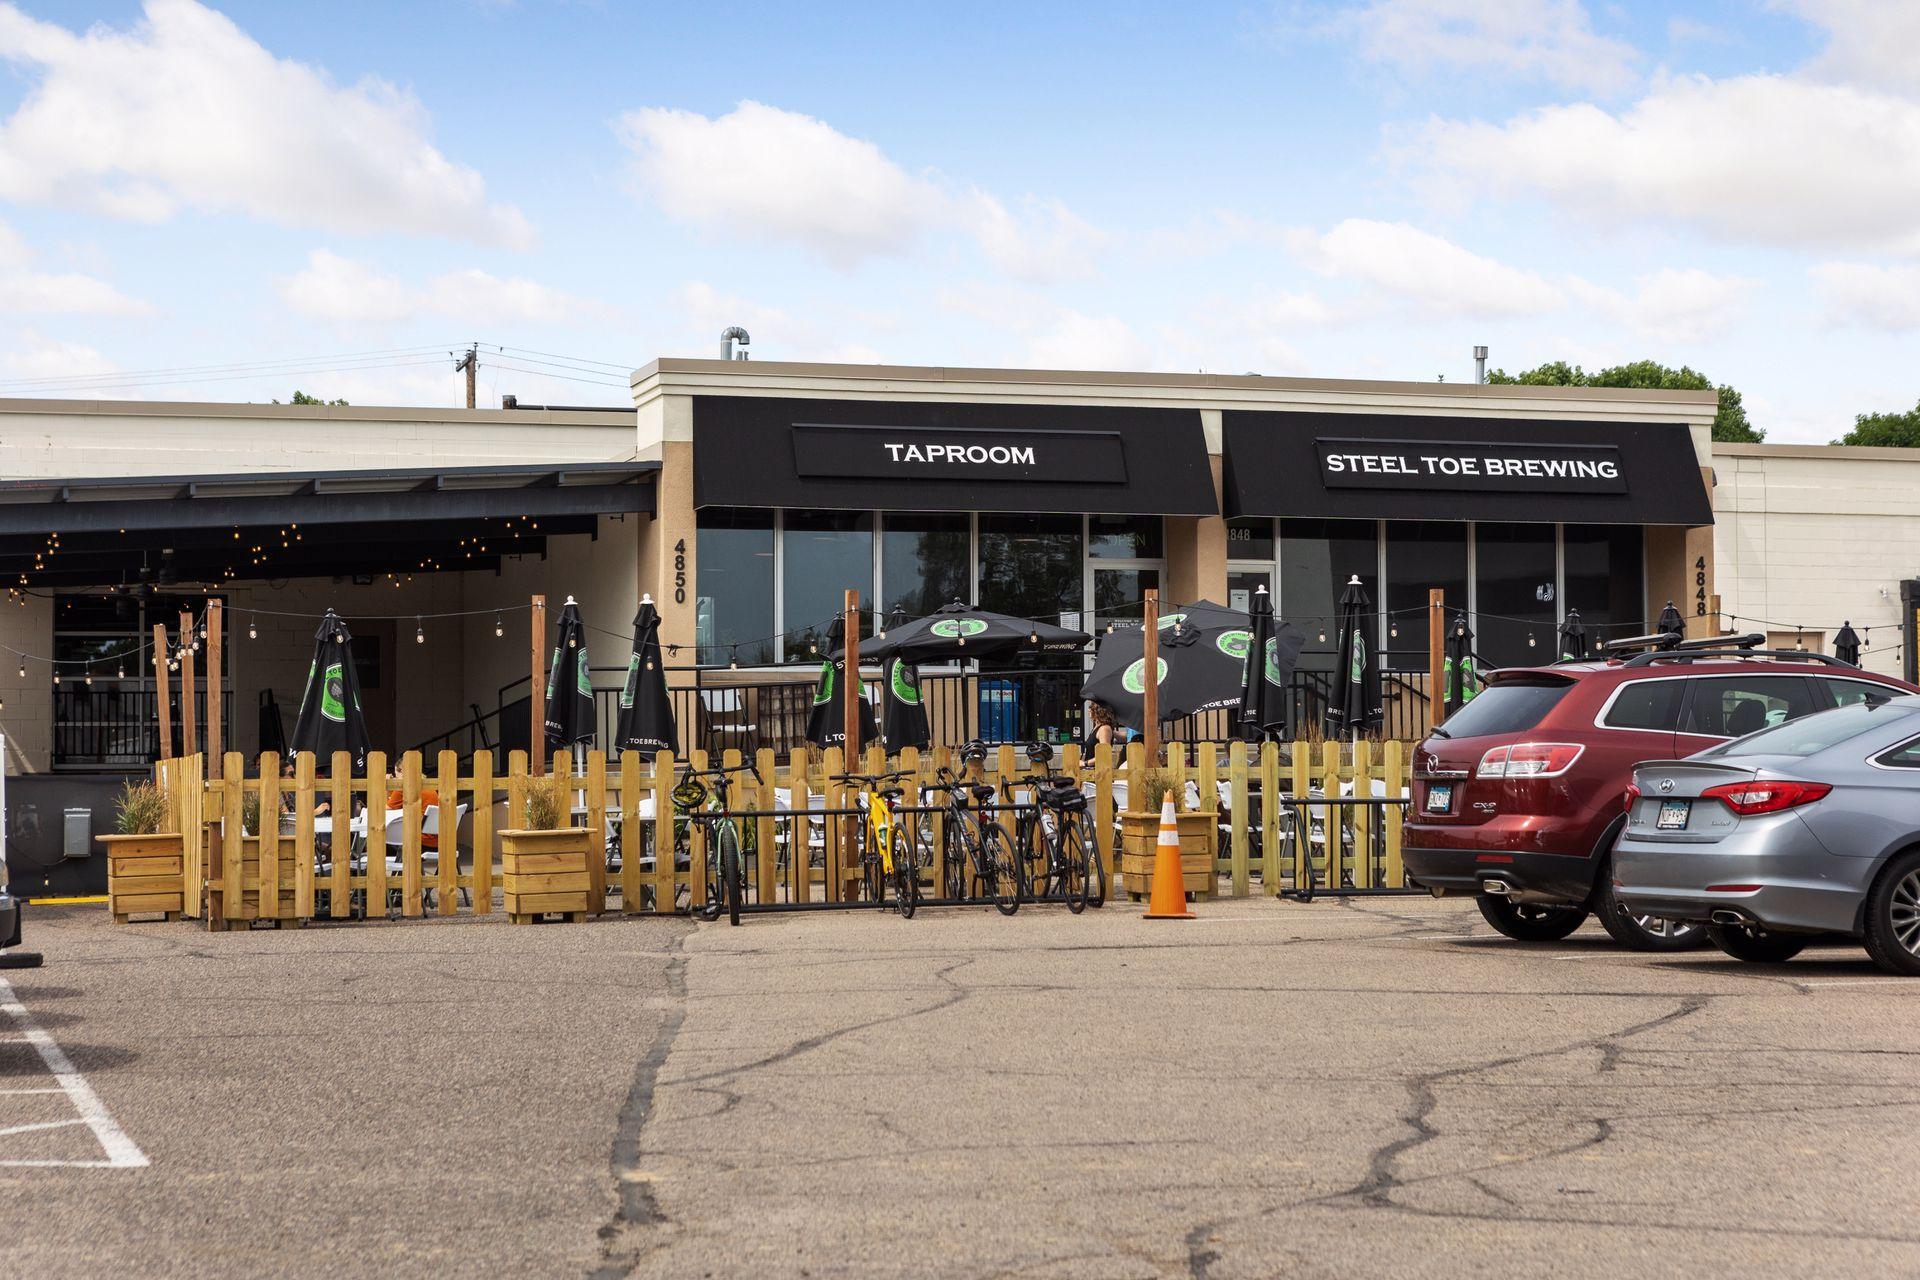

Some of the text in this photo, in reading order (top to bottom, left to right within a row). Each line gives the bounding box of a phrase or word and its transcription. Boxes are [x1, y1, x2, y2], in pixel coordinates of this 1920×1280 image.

[884, 443, 1036, 465] TAPROOM
[1326, 454, 1619, 479] STEEL TOE BREWING
[1227, 528, 1250, 541] 848
[674, 538, 686, 604] 4850
[1695, 556, 1706, 616] 4848
[832, 733, 846, 742] TO
